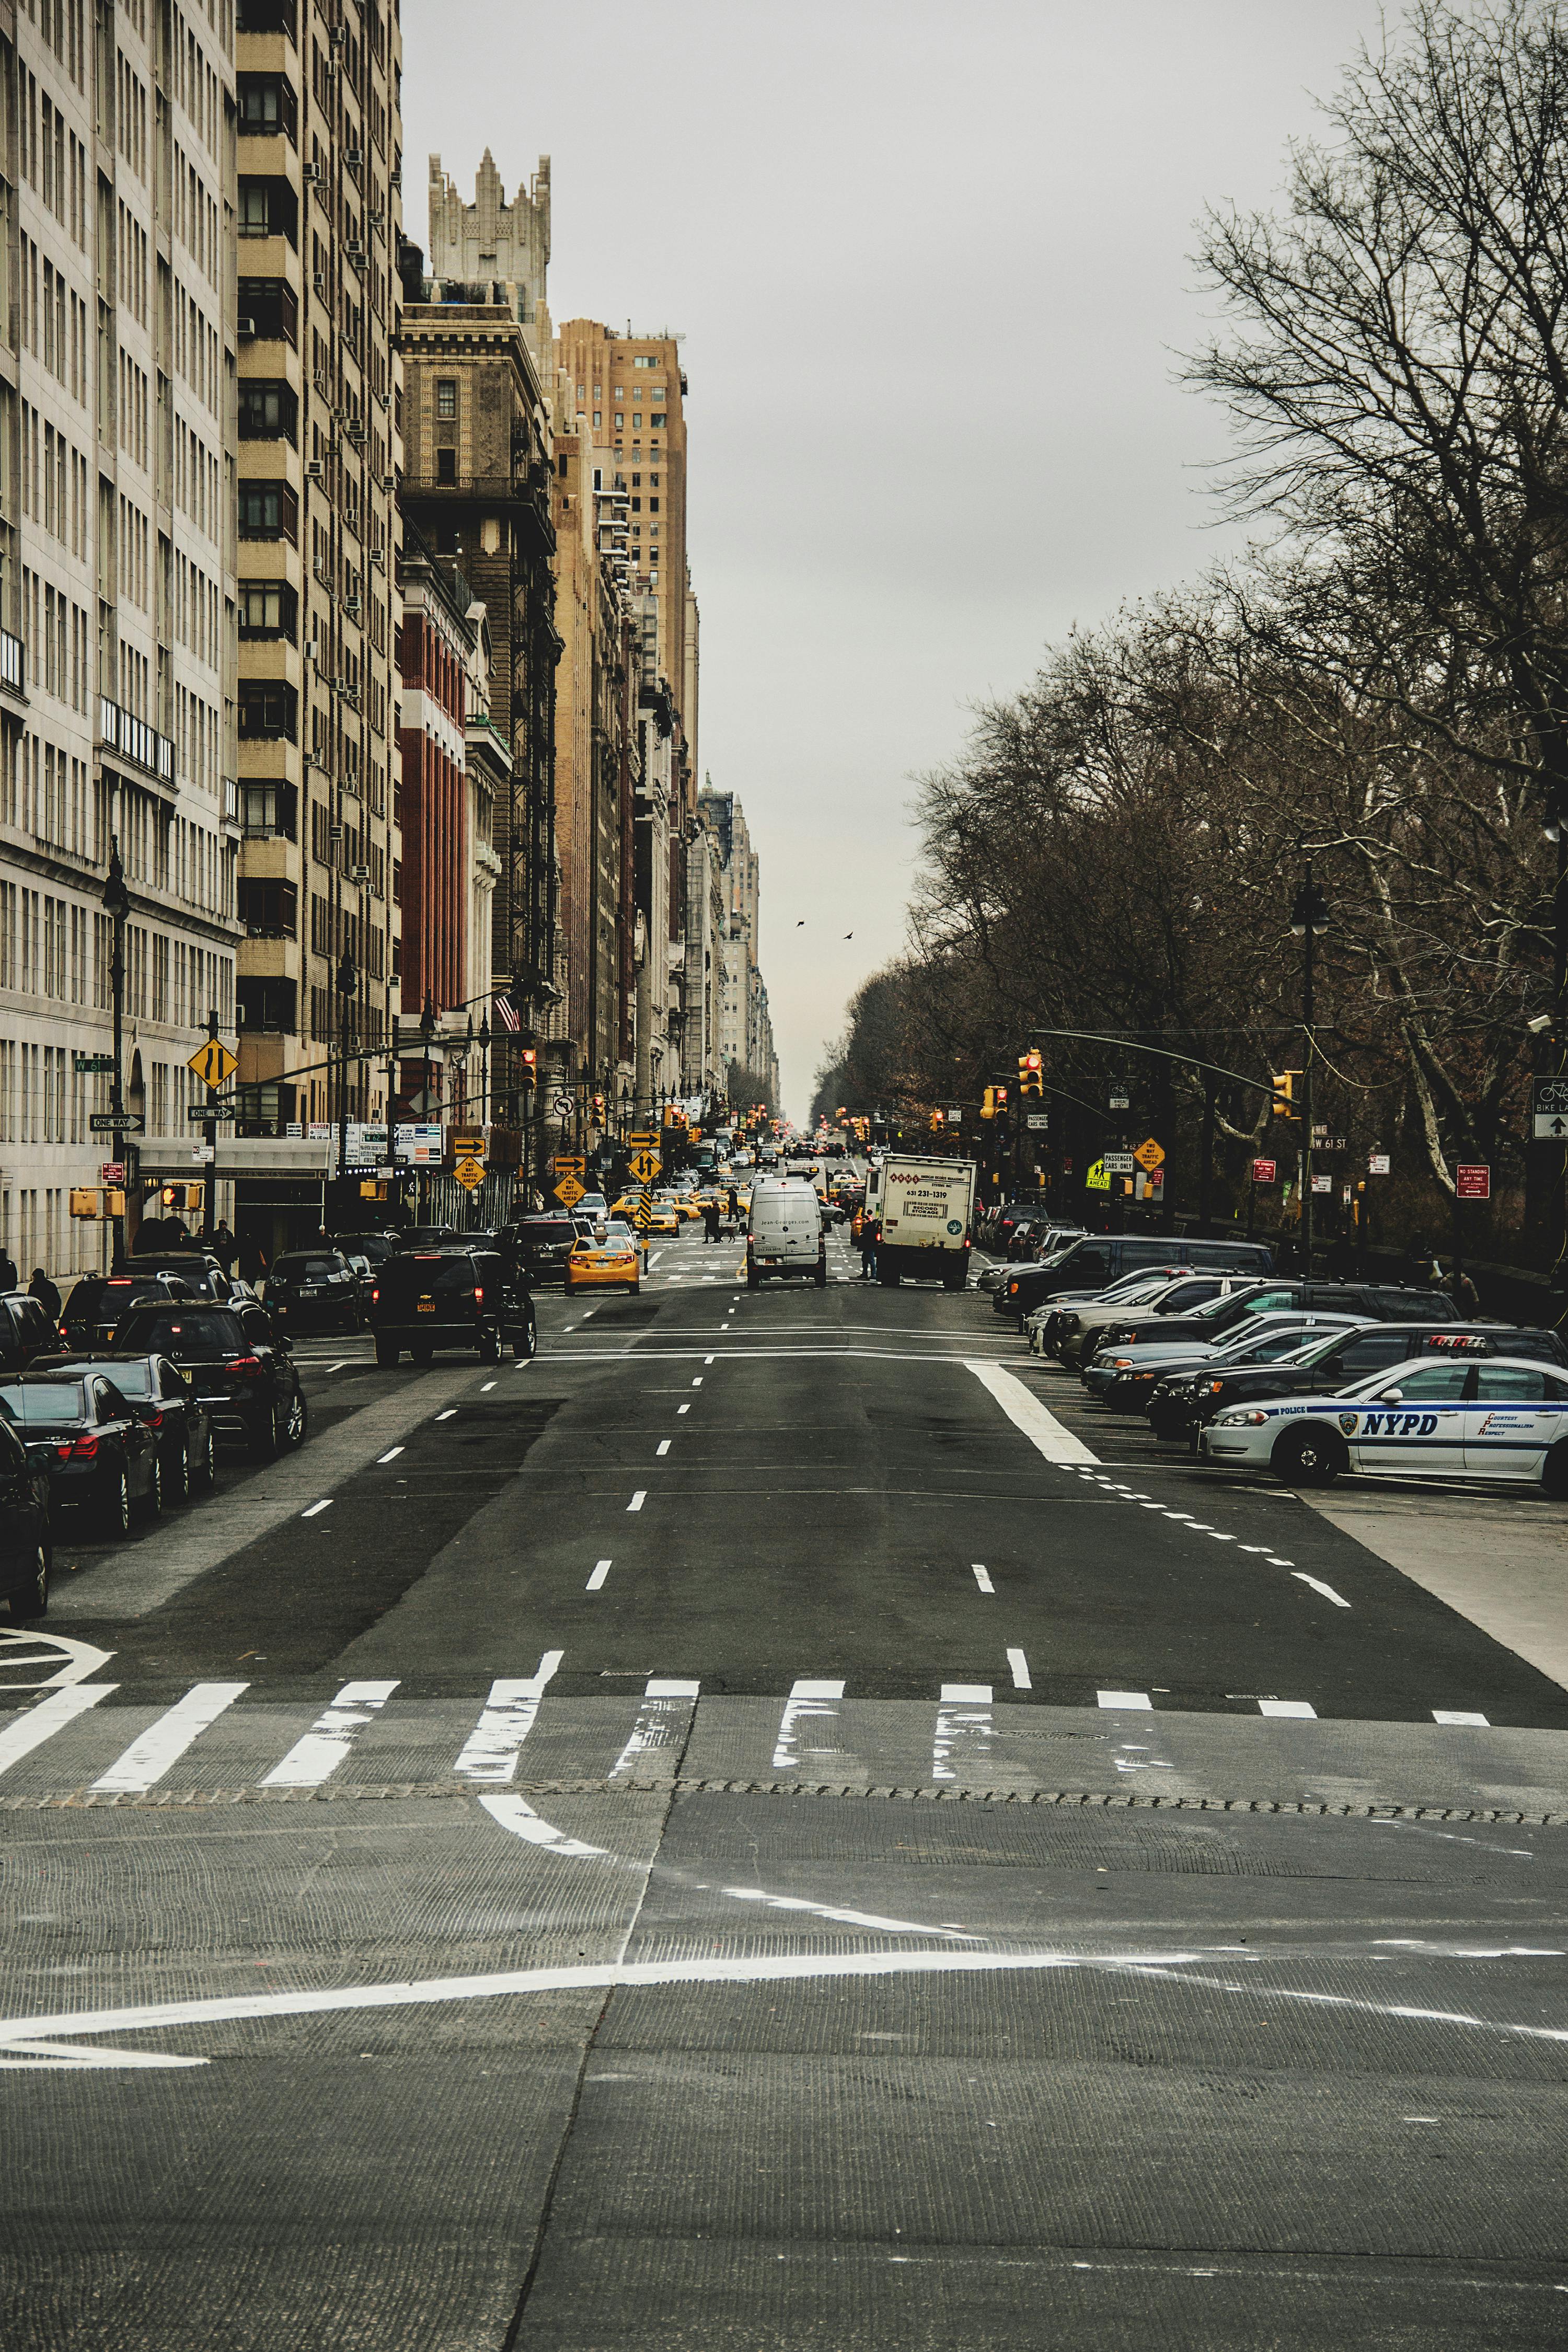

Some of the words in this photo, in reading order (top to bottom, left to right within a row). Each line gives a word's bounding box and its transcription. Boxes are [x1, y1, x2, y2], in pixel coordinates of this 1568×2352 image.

[77, 1061, 85, 1070] W
[91, 1061, 100, 1070] 61
[1316, 1139, 1322, 1148] W
[1325, 1139, 1333, 1148] 61
[1336, 1139, 1346, 1148] ST
[918, 1190, 947, 1198] 231-1319
[1280, 1406, 1306, 1415] POLICE
[1361, 1413, 1438, 1436] NYPD
[1483, 1420, 1534, 1428] PROFESSIONALISM
